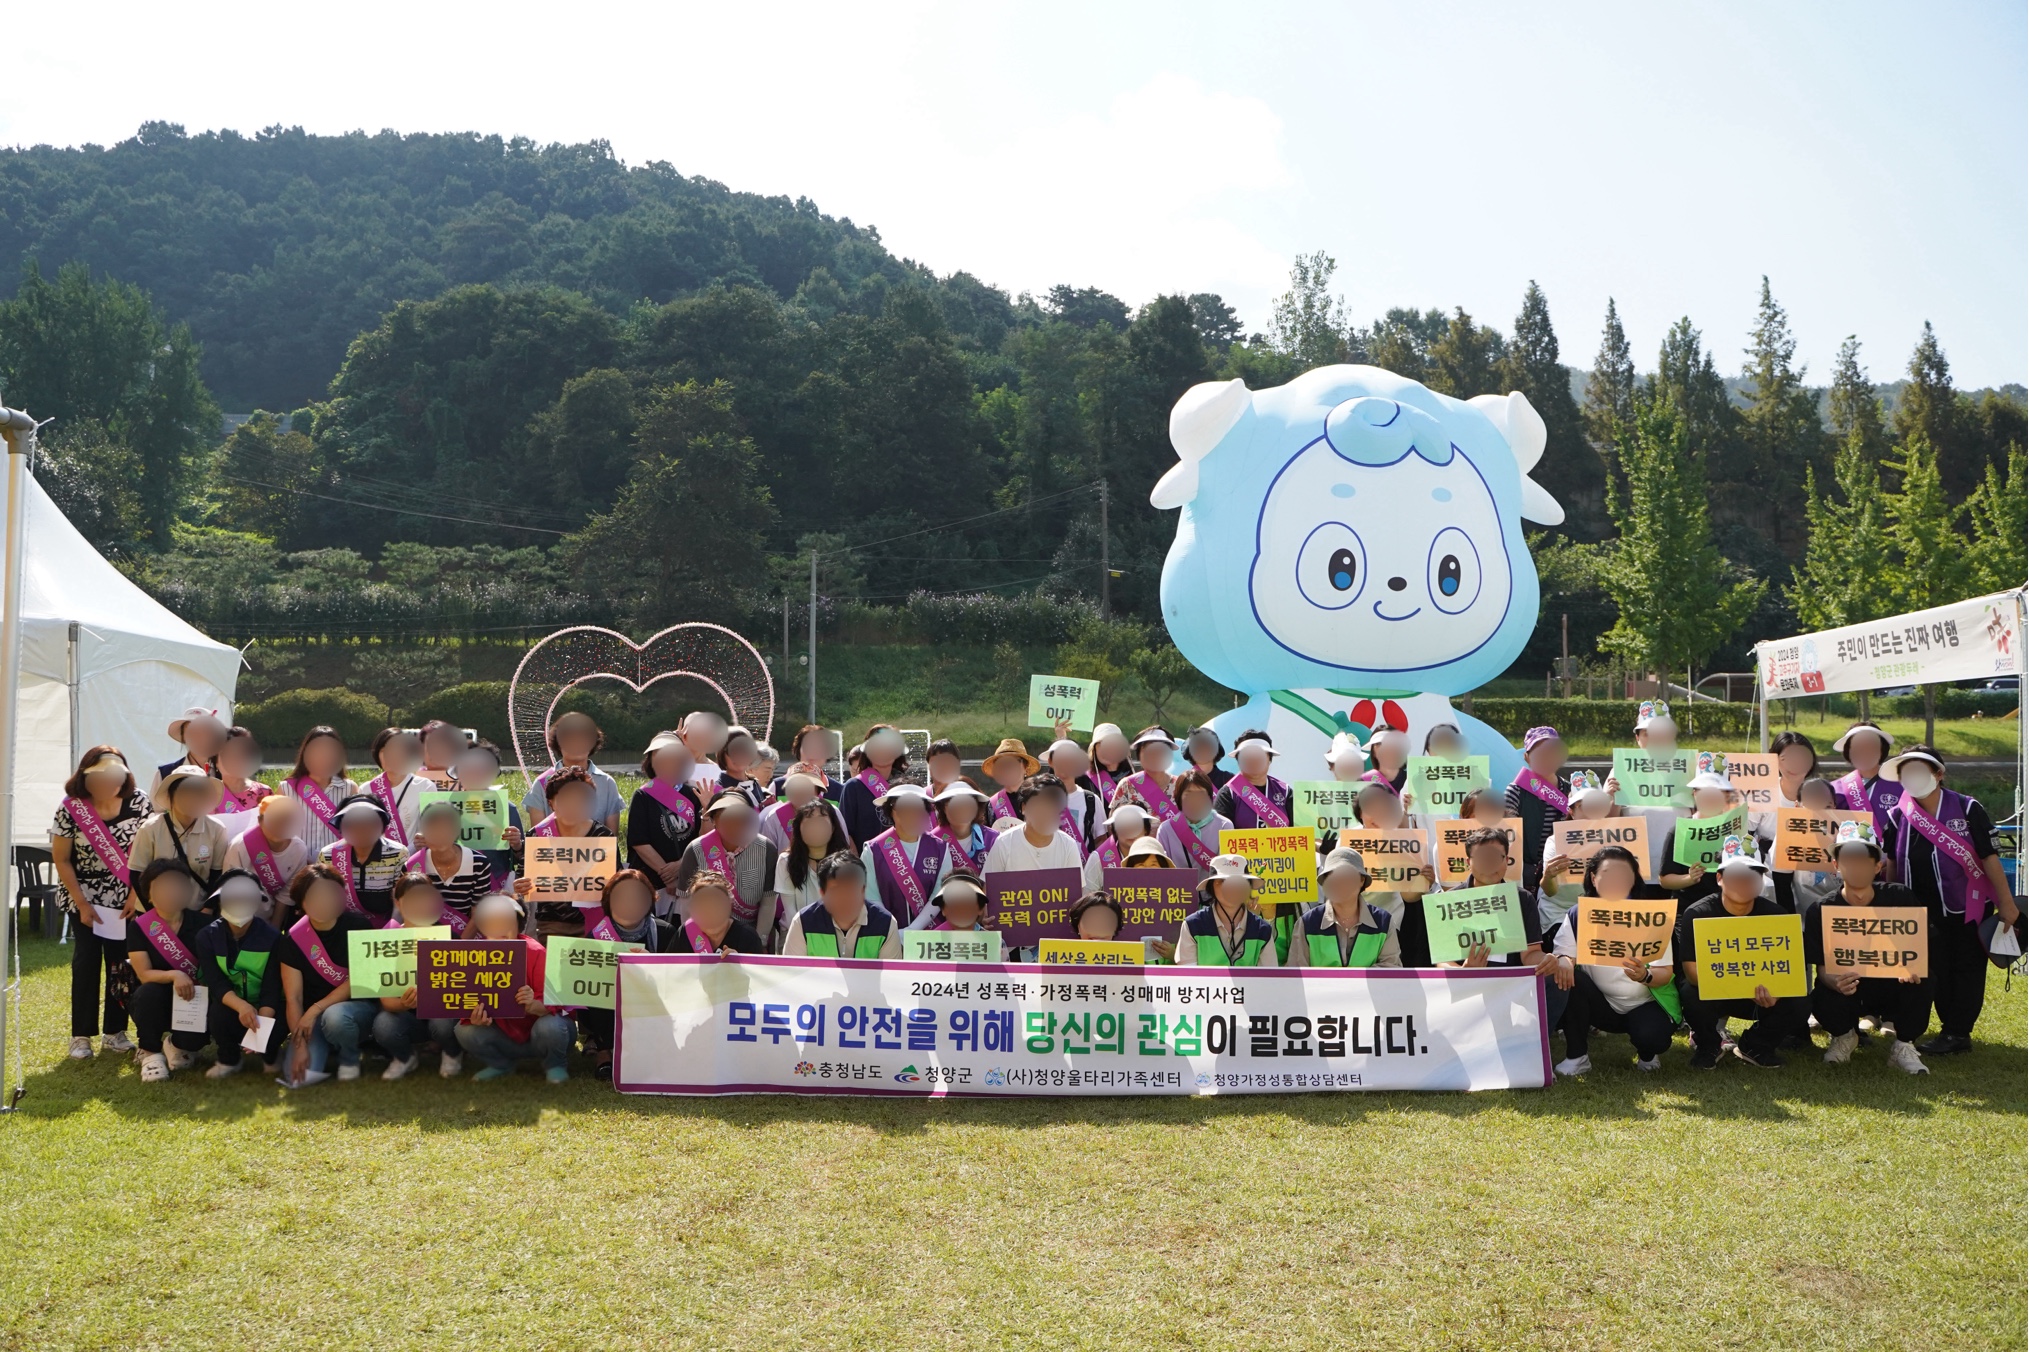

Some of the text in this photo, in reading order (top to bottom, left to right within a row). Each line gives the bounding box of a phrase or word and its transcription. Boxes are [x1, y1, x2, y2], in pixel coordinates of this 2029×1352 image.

[1838, 619, 1959, 662] 주민이 만드는 진짜 여행
[1778, 649, 1789, 662] 2024
[1045, 684, 1082, 699] 성폭력
[1046, 707, 1075, 720] OUT
[1425, 765, 1470, 780] 성폭력
[1625, 758, 1687, 774] 가정폭력
[1728, 762, 1769, 777] 력NO
[1431, 791, 1466, 805] OUT
[1540, 785, 1565, 806] 청양군
[1639, 785, 1675, 798] OUT
[310, 794, 335, 819] 청양군
[1248, 792, 1269, 813] 청양군
[1318, 816, 1352, 830] OUT
[1687, 815, 1742, 841] 가정폭력
[1788, 818, 1840, 836] 폭력N
[1912, 810, 1939, 836] 청양군
[461, 827, 485, 841] UT
[1566, 827, 1637, 846] 폭력NO
[535, 847, 606, 864] 폭력NO
[1349, 839, 1421, 854] 폭력ZERO
[889, 847, 909, 876] 청양군
[1365, 867, 1420, 883] 복UP
[535, 876, 605, 893] 존중YES
[1000, 888, 1068, 907] 관심 ON!
[1109, 887, 1193, 904] 가정폭력 없는
[1160, 907, 1187, 925] 사회
[1436, 895, 1508, 921] 가정폭력
[998, 910, 1031, 928] 폭력
[1590, 909, 1667, 928] 폭력NO
[1831, 917, 1918, 935] 폭력ZERO
[157, 932, 184, 960] 청양군
[1458, 928, 1498, 948] OUT
[1745, 936, 1791, 952] 모두가
[916, 942, 988, 960] 가정폭력
[1589, 939, 1662, 958] 존중YES
[1833, 947, 1918, 968] 행복UP
[430, 949, 513, 967] 함께해요!
[317, 956, 344, 981] 청양군
[1711, 959, 1791, 978] 행복한 사회
[430, 970, 513, 989] 밝은 세상
[573, 980, 615, 998] OUT
[911, 982, 969, 999] 2024년
[1178, 986, 1245, 1004] 방지사업
[442, 993, 499, 1010] 만들기
[727, 1002, 1428, 1057] 모두의 안전을 위해 당신의 관심이 필요합니다.
[818, 1063, 882, 1080] 충청남도
[925, 1066, 972, 1084] 청양군
[1007, 1068, 1181, 1088] (사)청양울타리가족센터
[1214, 1073, 1362, 1087] 청양가정성통합상담센터
